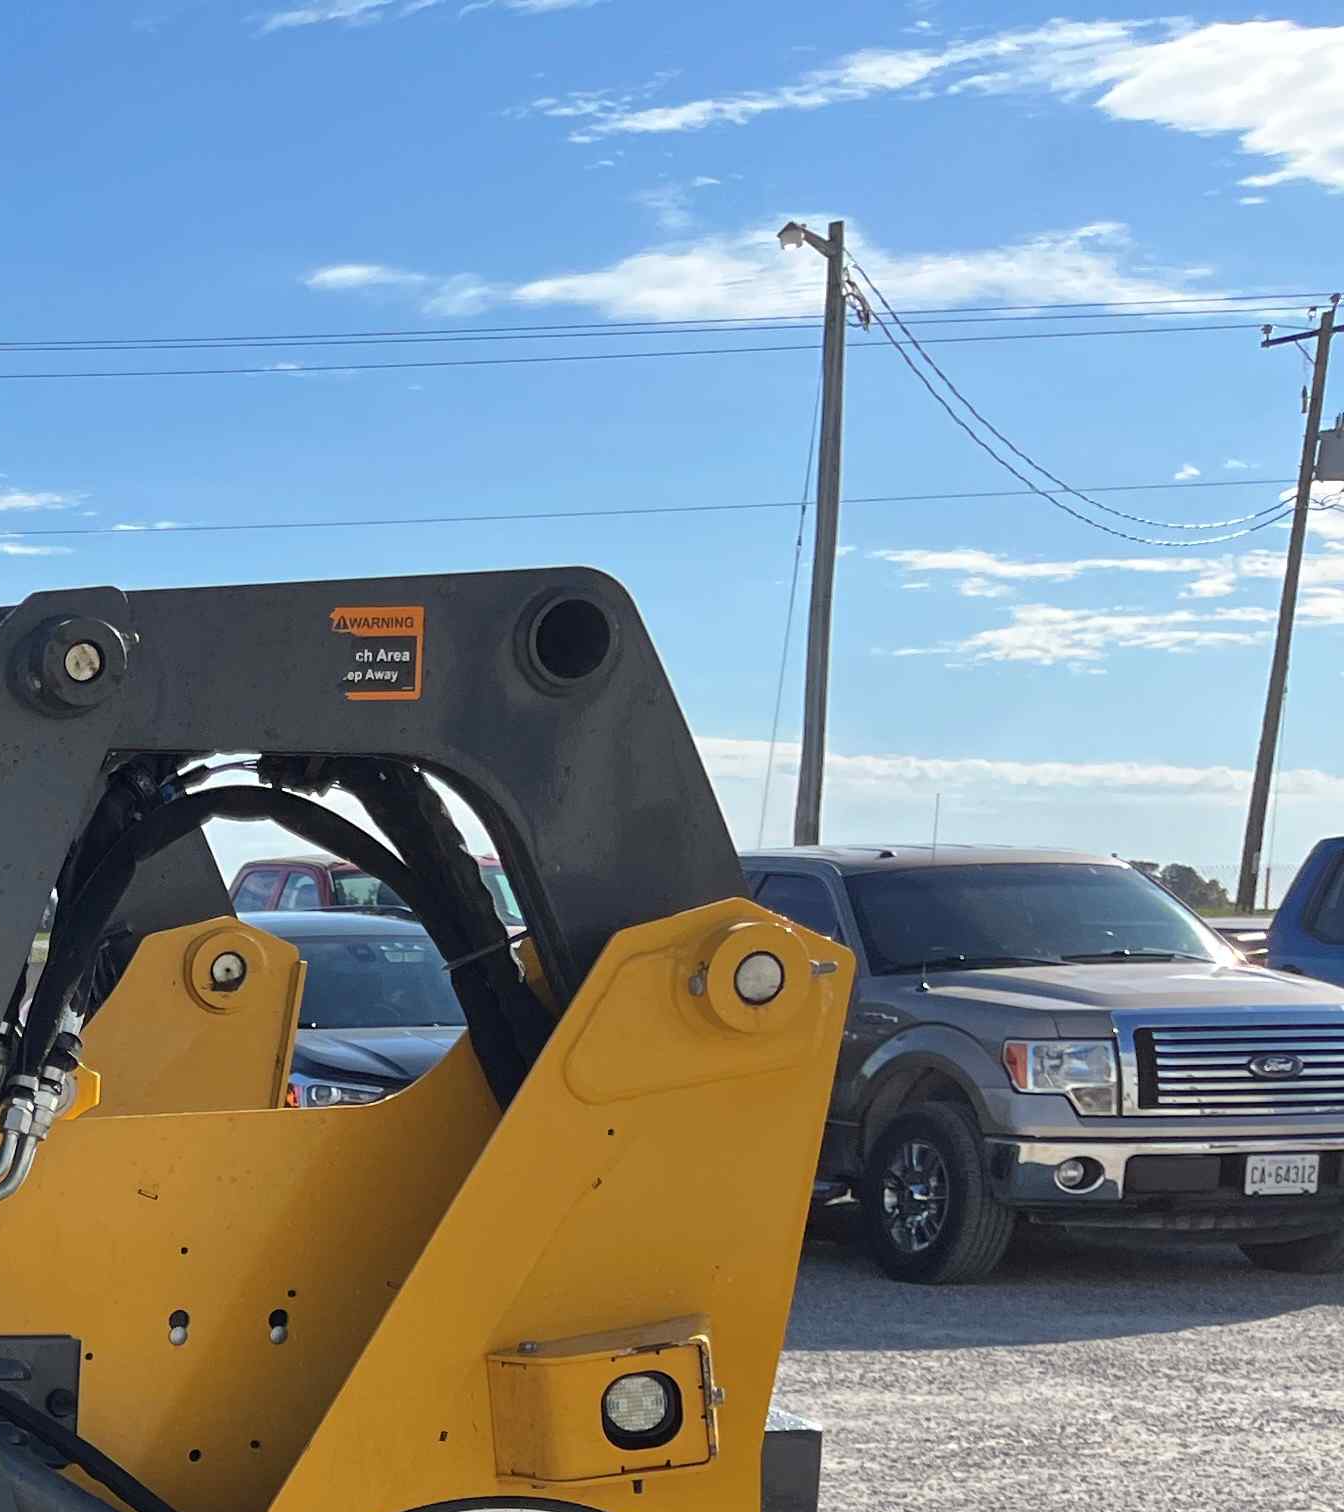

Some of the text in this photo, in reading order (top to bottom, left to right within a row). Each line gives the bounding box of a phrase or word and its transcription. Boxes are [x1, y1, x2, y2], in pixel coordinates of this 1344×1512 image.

[349, 616, 414, 628] WARNING
[376, 648, 410, 662] Area
[365, 669, 398, 682] Away
[1274, 1164, 1316, 1184] 64312
